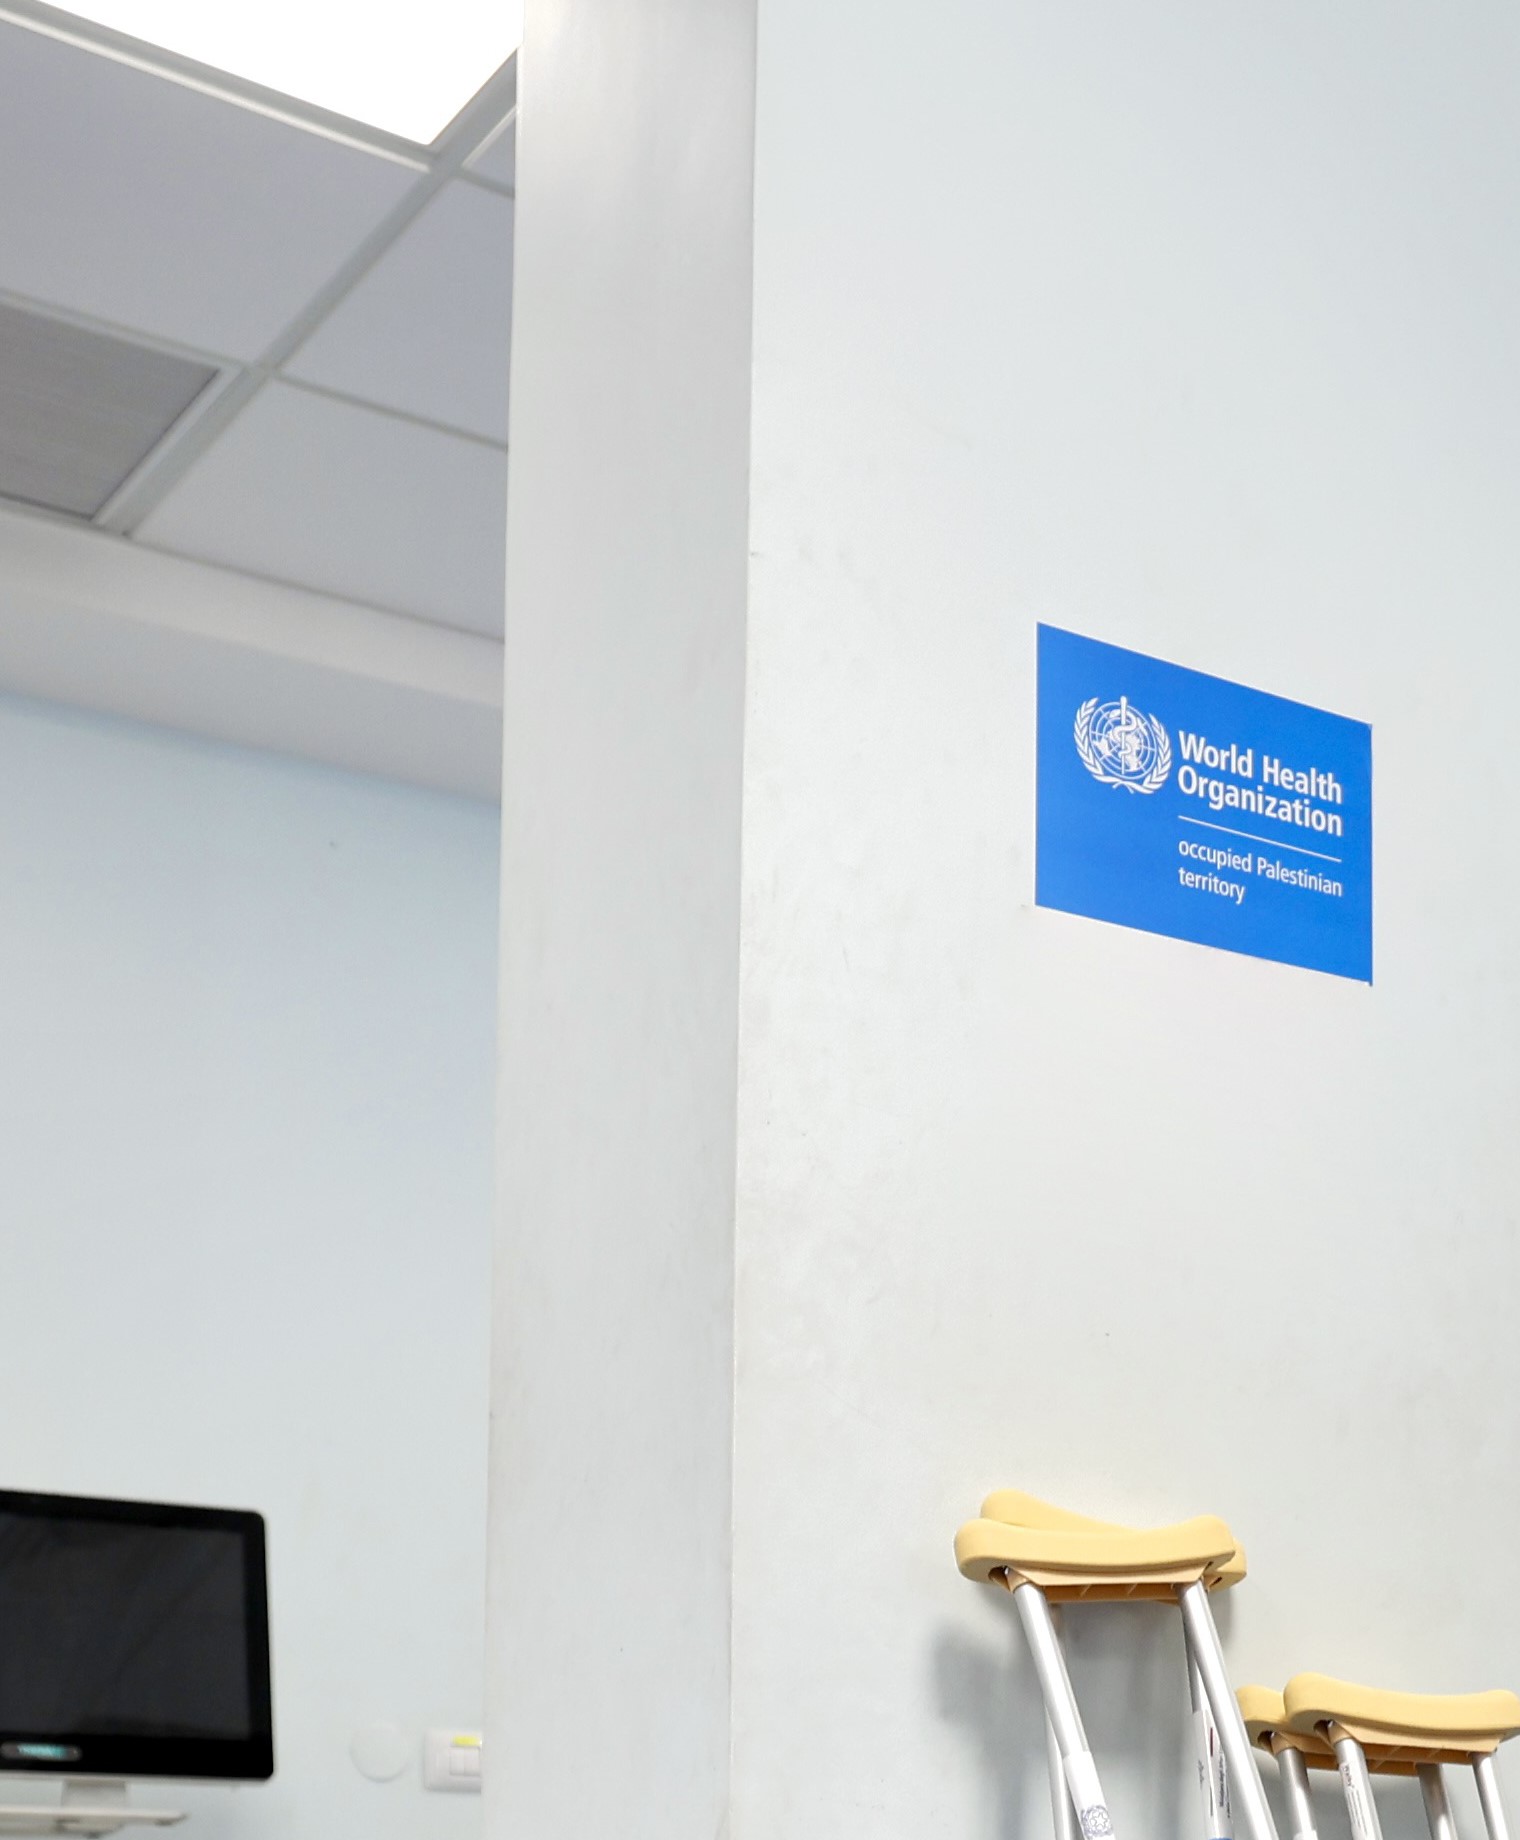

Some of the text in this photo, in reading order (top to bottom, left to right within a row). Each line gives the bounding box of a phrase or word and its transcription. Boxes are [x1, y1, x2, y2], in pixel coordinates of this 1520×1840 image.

[1178, 729, 1343, 804] World Health
[1178, 765, 1343, 837] Organization
[1178, 839, 1343, 898] occupied Palestinian
[1178, 866, 1246, 905] territory
